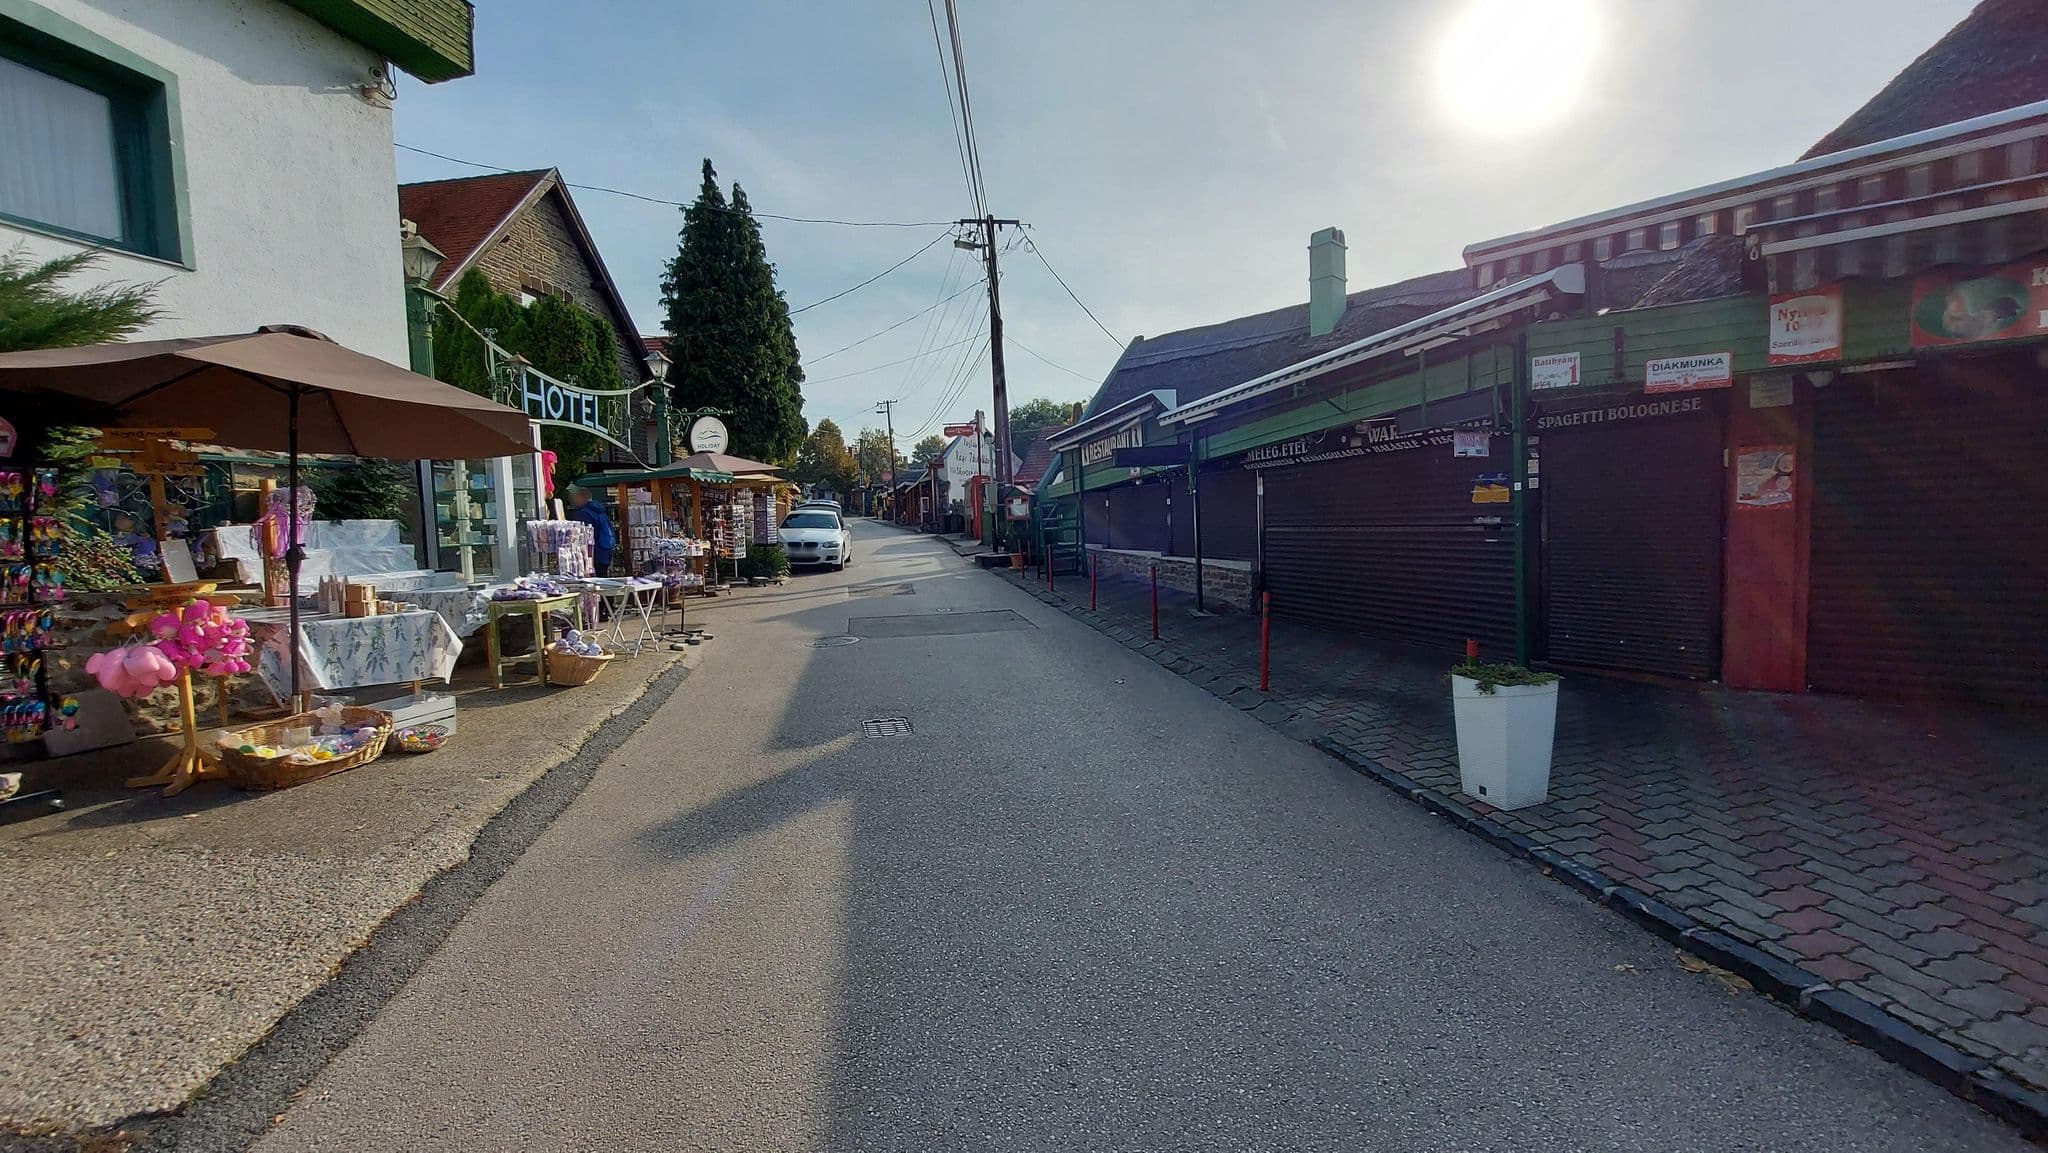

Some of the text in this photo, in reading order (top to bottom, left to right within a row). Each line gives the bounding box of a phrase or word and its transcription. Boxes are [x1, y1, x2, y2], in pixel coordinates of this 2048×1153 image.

[523, 373, 609, 434] HOTEL
[1537, 397, 1701, 430] SPAGETTI BOLOGNESE
